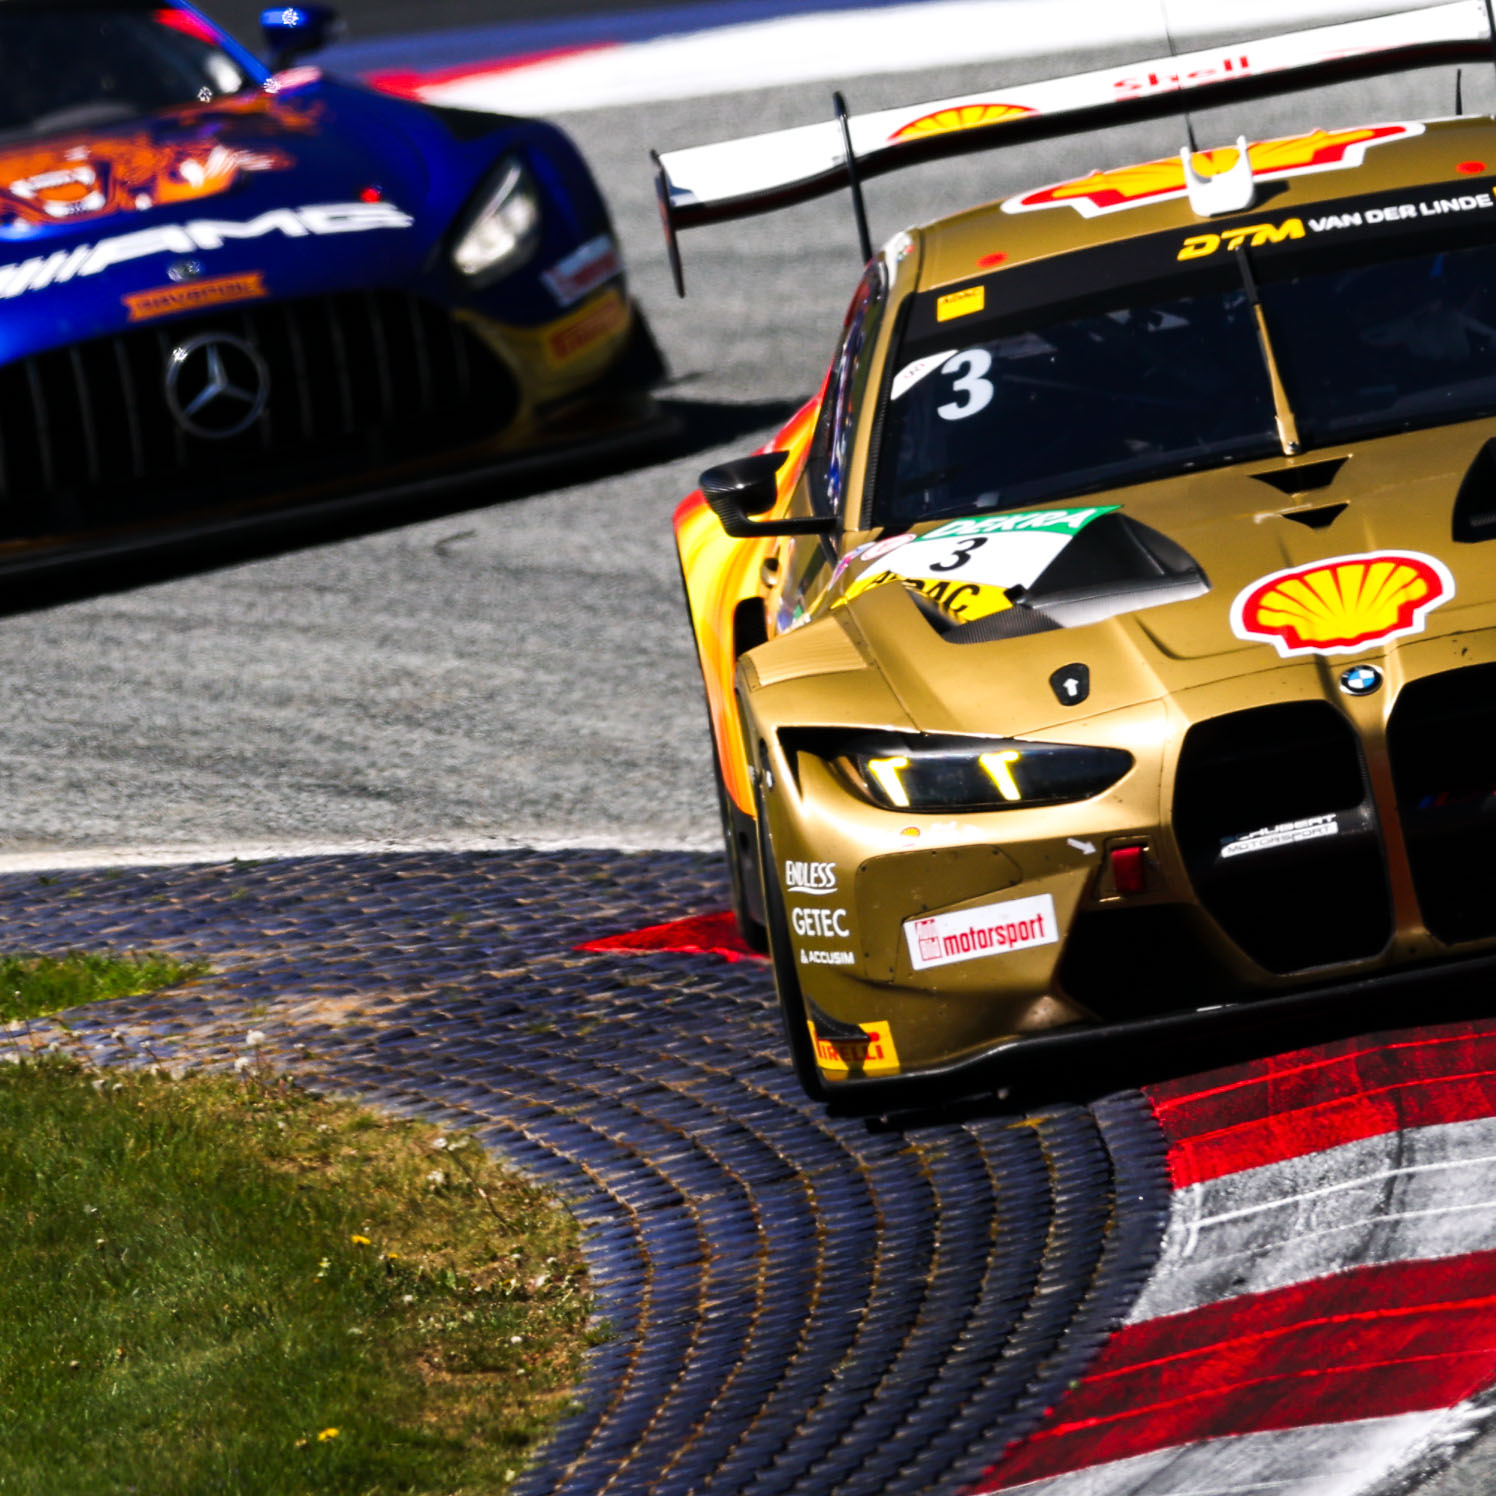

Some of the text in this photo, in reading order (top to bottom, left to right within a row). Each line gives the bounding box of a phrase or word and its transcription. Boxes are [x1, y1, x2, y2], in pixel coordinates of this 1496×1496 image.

[1113, 55, 1250, 92] Shell
[1177, 193, 1494, 261] DTM VAN DER LINDE
[937, 348, 995, 421] 3
[921, 508, 1097, 540] DEKRA
[928, 536, 989, 573] 3
[1227, 824, 1331, 854] MOTORSPORT
[785, 860, 837, 888] ENDLESS
[791, 907, 850, 937] GETEC
[942, 912, 1046, 957] motorsport
[808, 950, 854, 965] ACCUSIM
